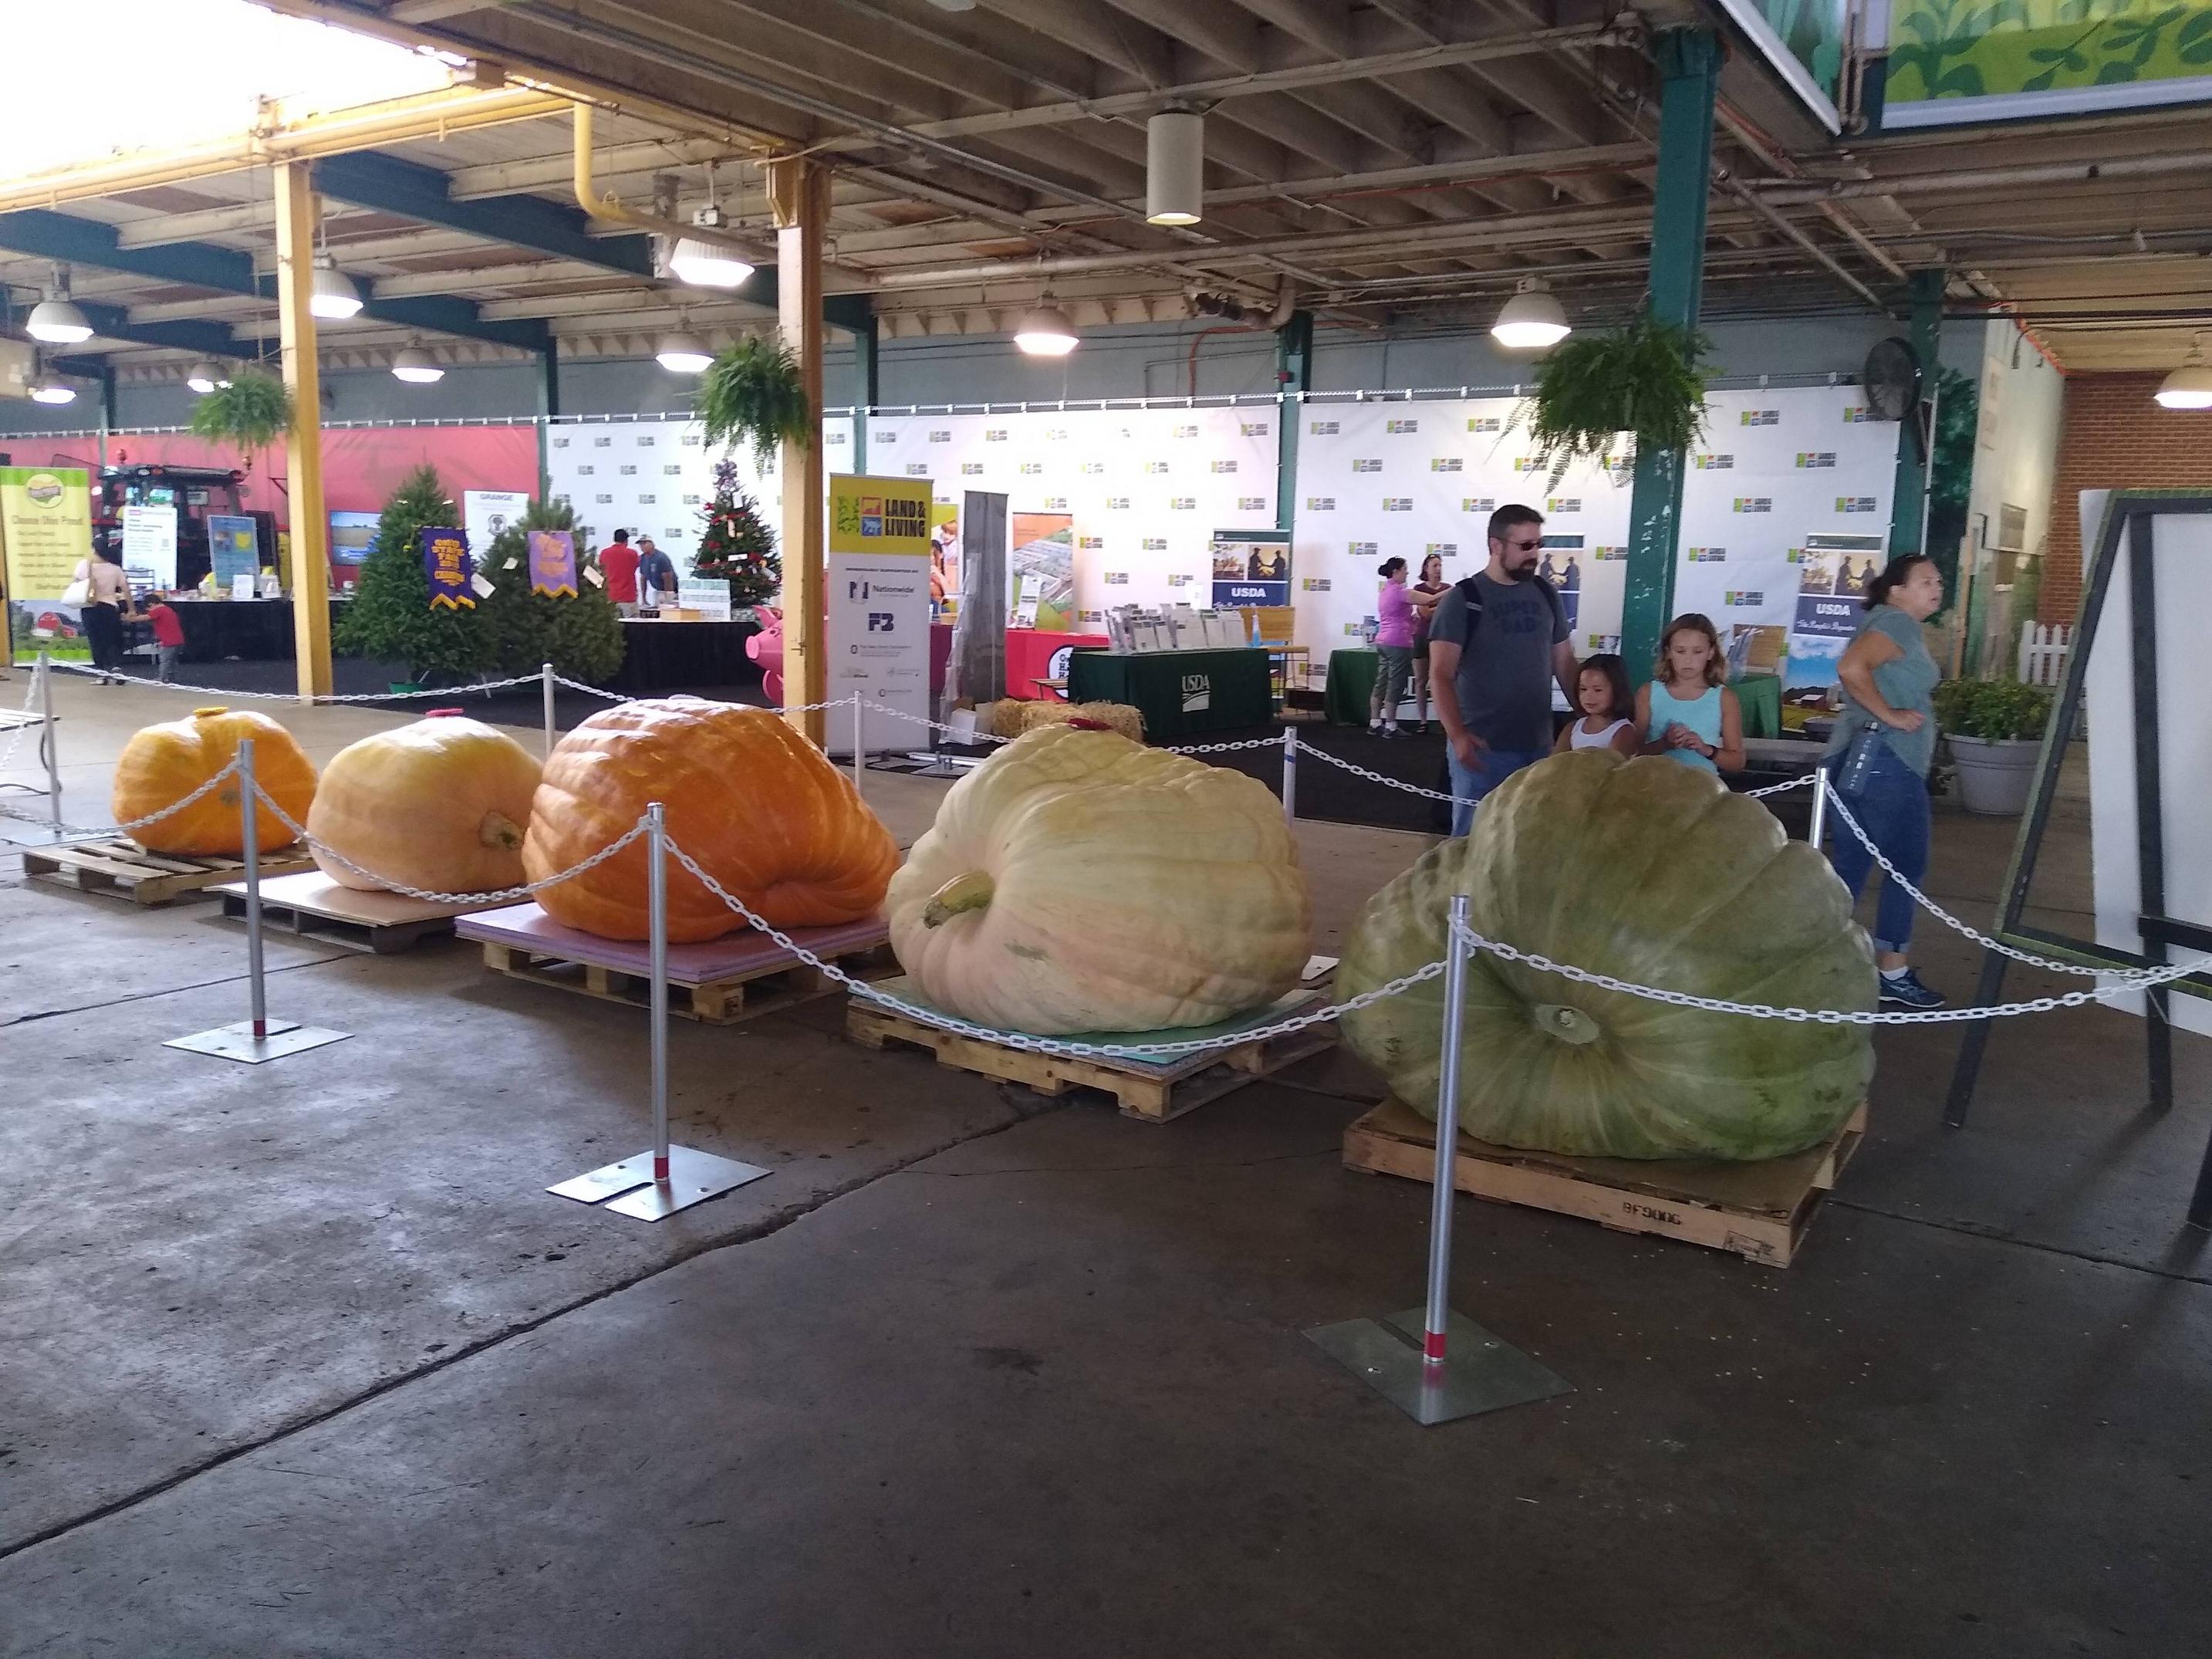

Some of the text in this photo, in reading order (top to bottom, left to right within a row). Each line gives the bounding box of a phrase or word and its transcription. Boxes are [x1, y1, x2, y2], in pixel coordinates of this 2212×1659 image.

[885, 498, 916, 518] LAND
[885, 519, 925, 537] LIVING
[872, 585, 914, 593] Nationwide
[1231, 587, 1266, 598] USDA
[1815, 603, 1851, 617] USDA
[1181, 674, 1211, 691] USDA
